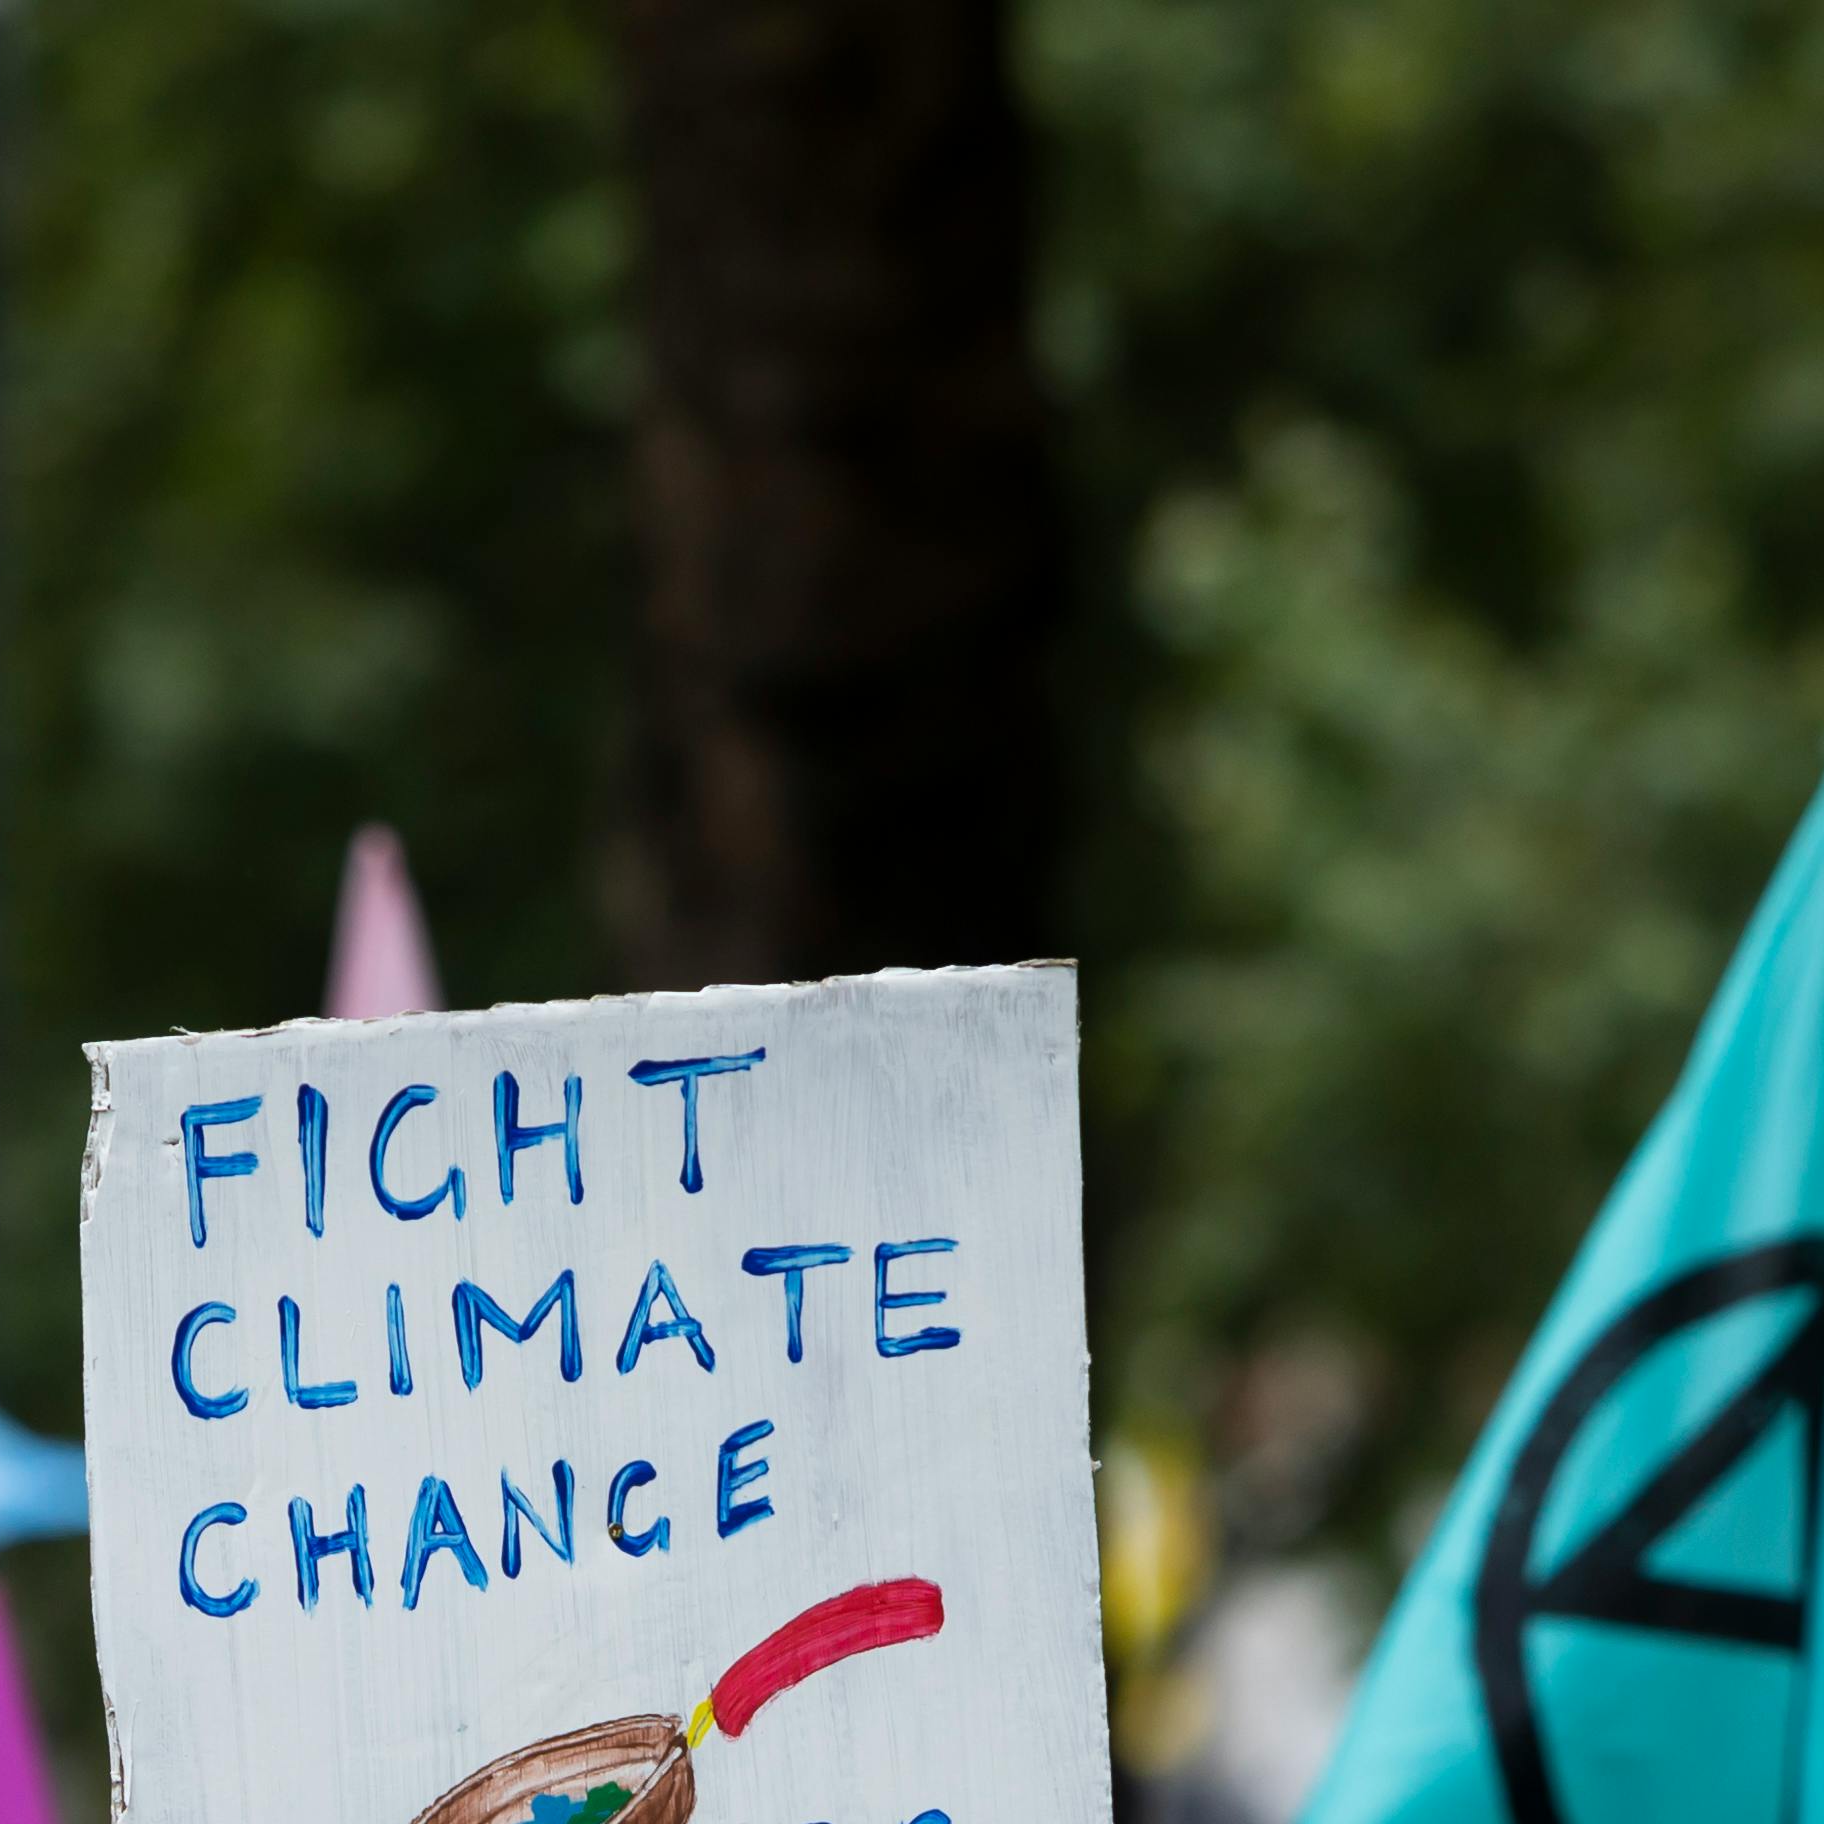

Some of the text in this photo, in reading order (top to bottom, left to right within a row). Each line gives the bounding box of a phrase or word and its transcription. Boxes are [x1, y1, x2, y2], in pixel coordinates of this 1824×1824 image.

[179, 1045, 768, 1250] FIGHT
[170, 1235, 964, 1423] CLIMATE
[177, 1417, 776, 1620] CHANGE
